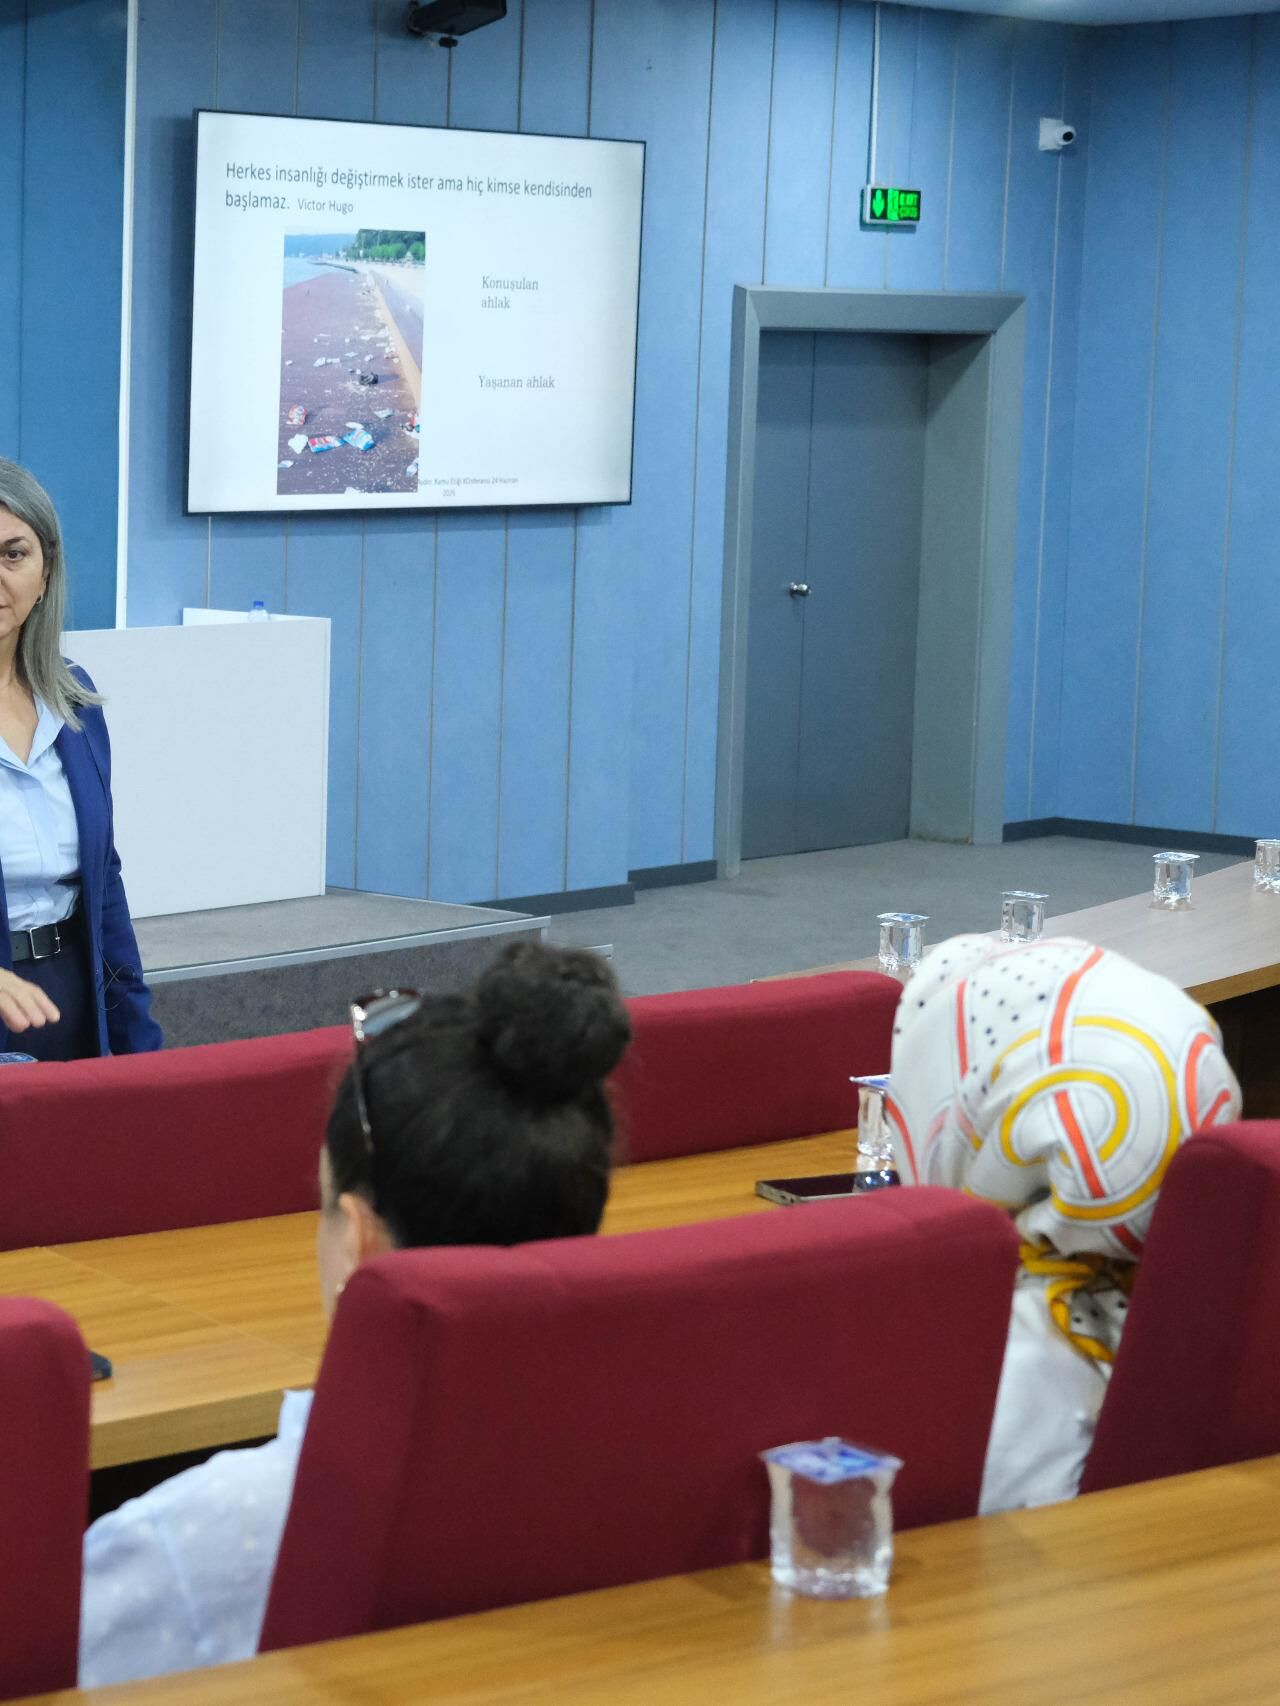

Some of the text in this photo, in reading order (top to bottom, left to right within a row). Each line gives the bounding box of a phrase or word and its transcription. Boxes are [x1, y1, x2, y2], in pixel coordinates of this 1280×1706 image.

[226, 162, 593, 199] Herkes insanlığı değiştirmek ister ama hiç kimse kendisinden
[225, 190, 355, 215] başlamaz. Victor Hugo
[482, 275, 539, 292] Konuşulan
[481, 296, 511, 309] ahlak
[478, 375, 555, 390] Yaşanan ahlak
